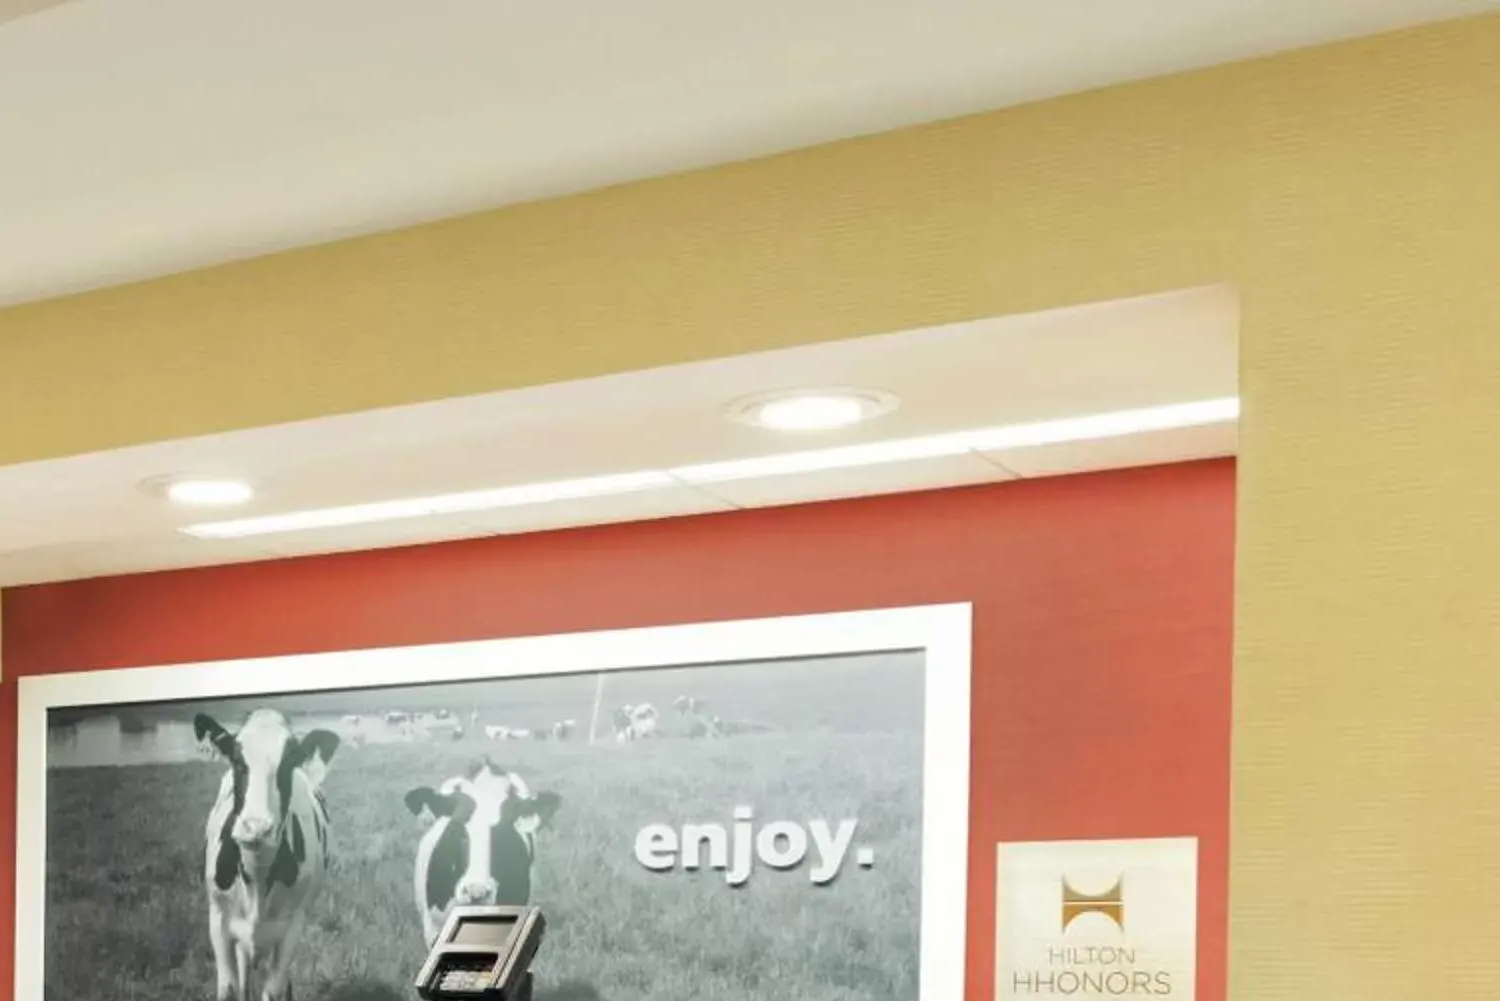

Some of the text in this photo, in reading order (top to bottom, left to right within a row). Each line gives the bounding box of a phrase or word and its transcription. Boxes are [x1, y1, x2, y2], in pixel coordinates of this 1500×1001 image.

[634, 805, 874, 884] enjoy.
[1048, 945, 1136, 965] HILTON
[1012, 970, 1172, 996] HHONORS
